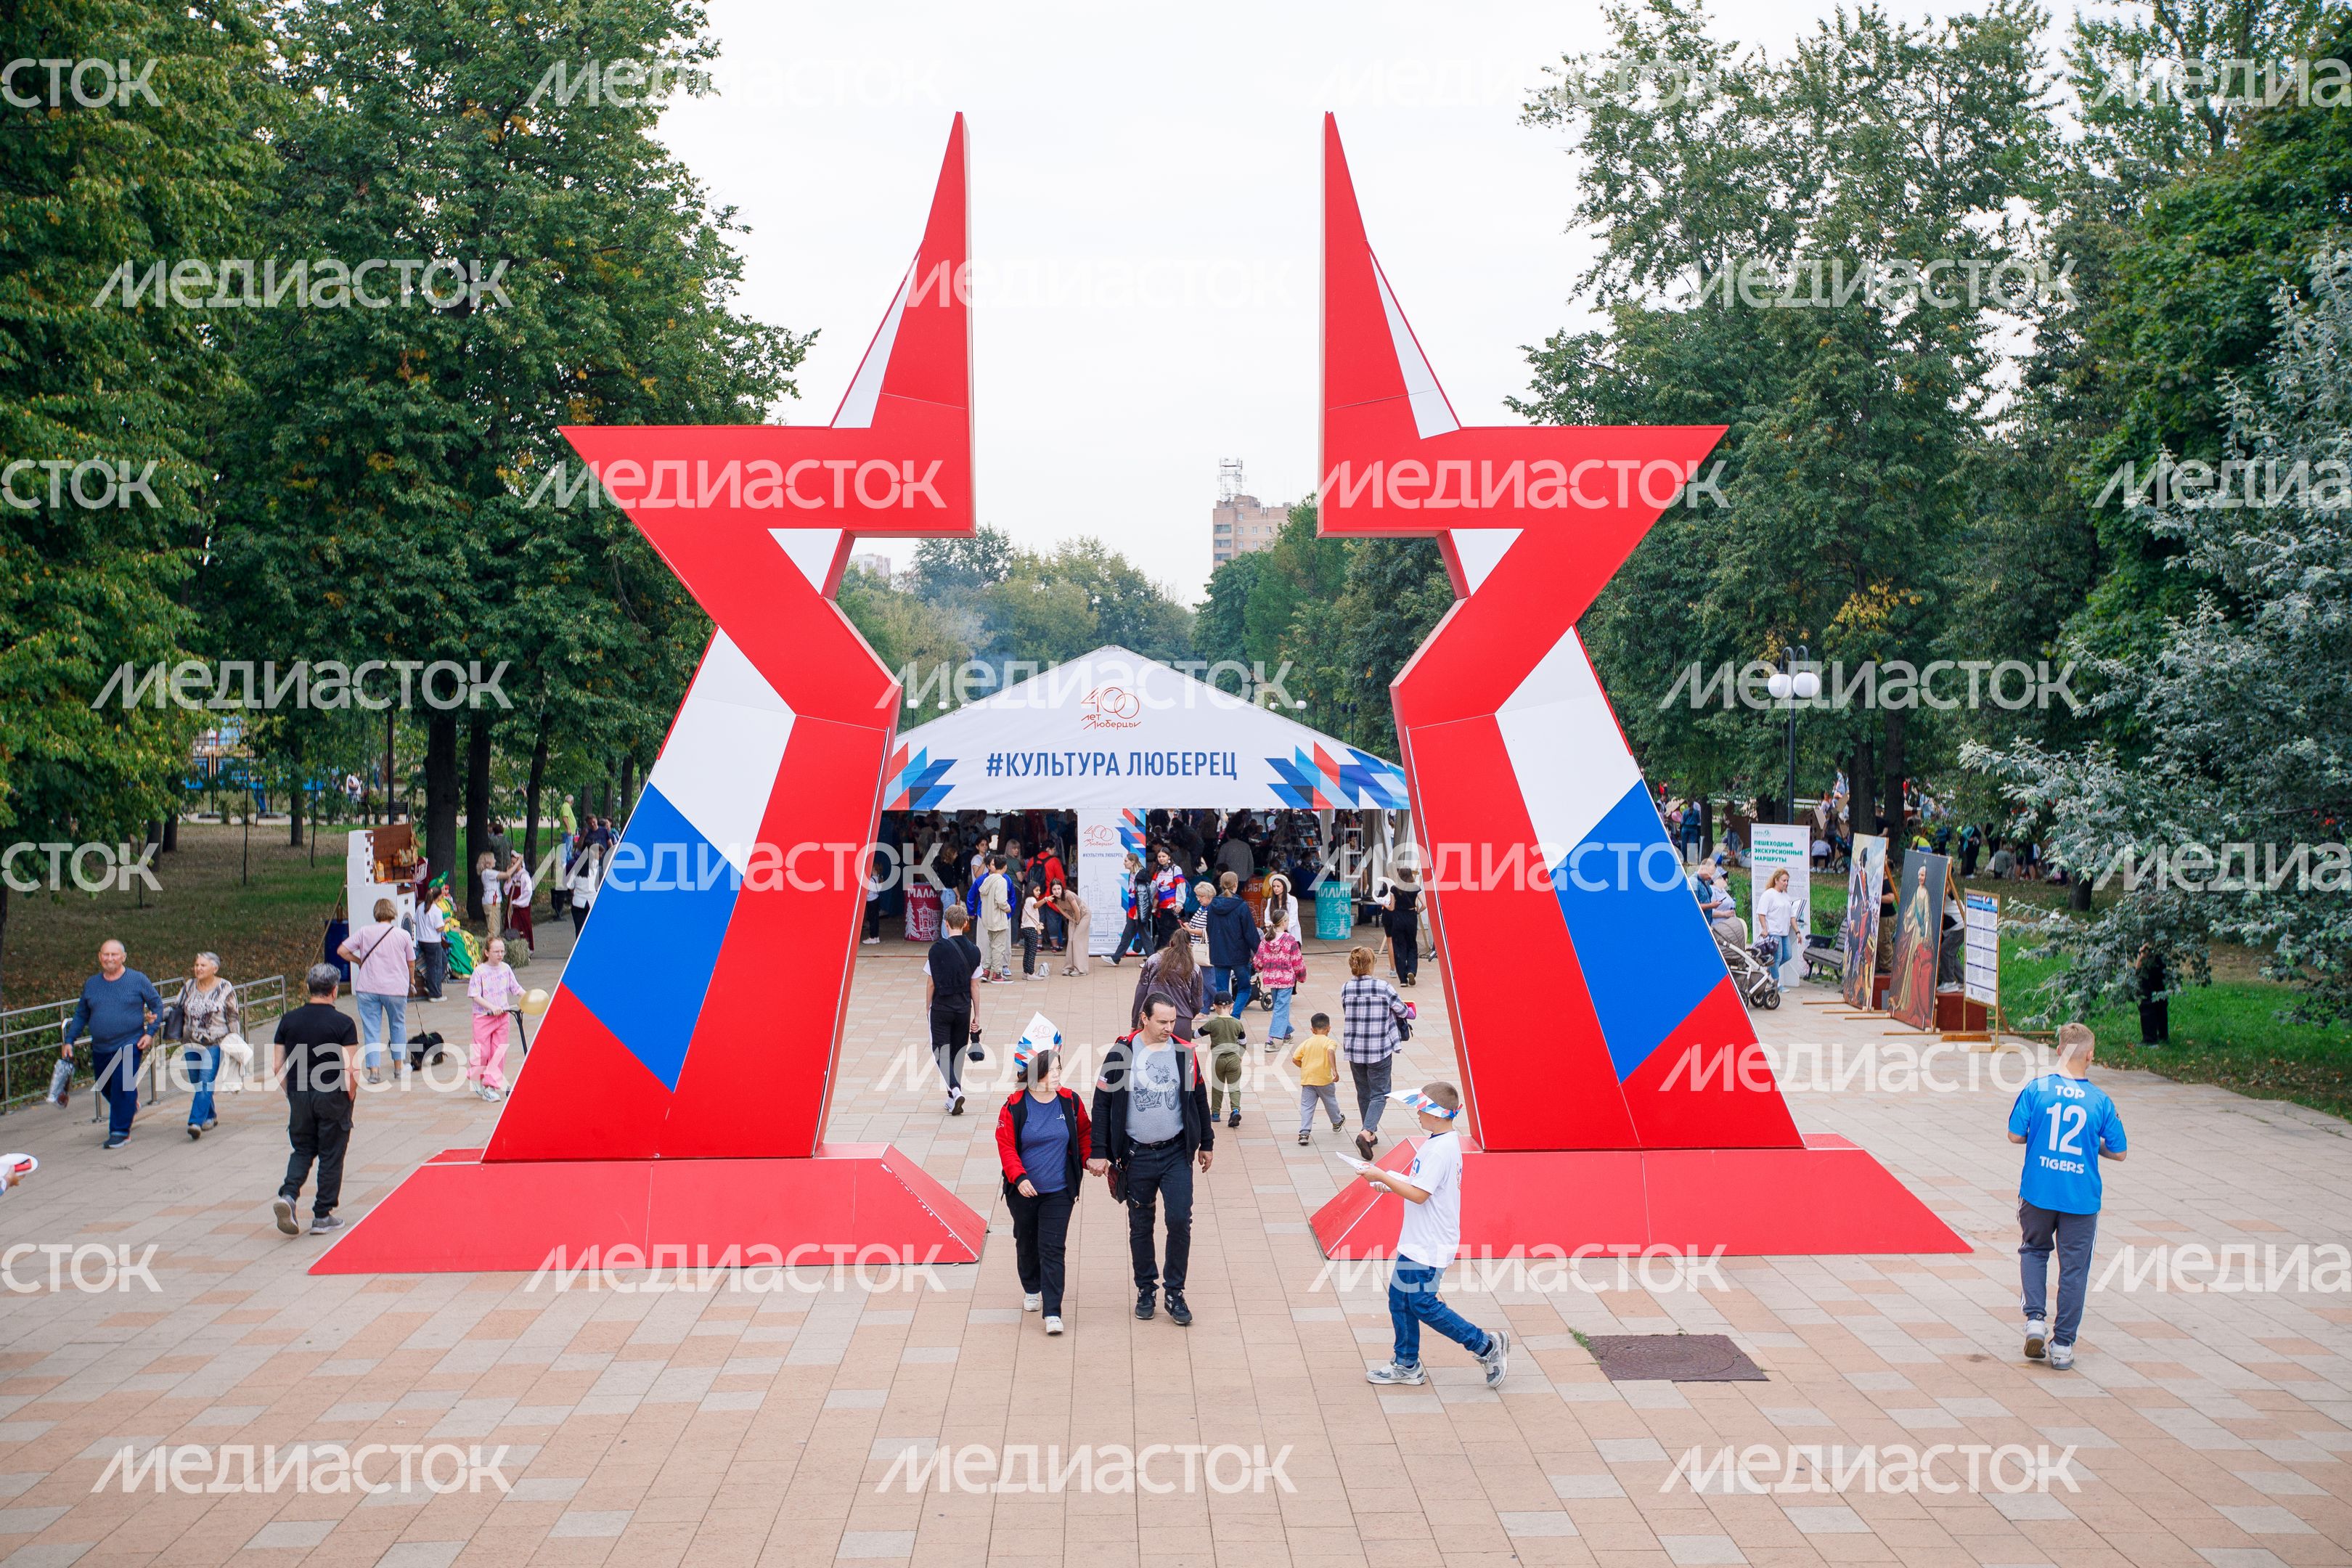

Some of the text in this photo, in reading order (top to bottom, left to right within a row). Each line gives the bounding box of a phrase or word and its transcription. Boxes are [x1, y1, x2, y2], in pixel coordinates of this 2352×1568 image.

[1081, 687, 1140, 719] 400
[986, 751, 1238, 780] #КУЛЬТУРА ЛЮБЕРЕЦ
[907, 888, 937, 898] МАЛА
[2055, 1085, 2086, 1099] TOP
[2046, 1102, 2088, 1156] 12
[2039, 1156, 2085, 1175] TIGERS
